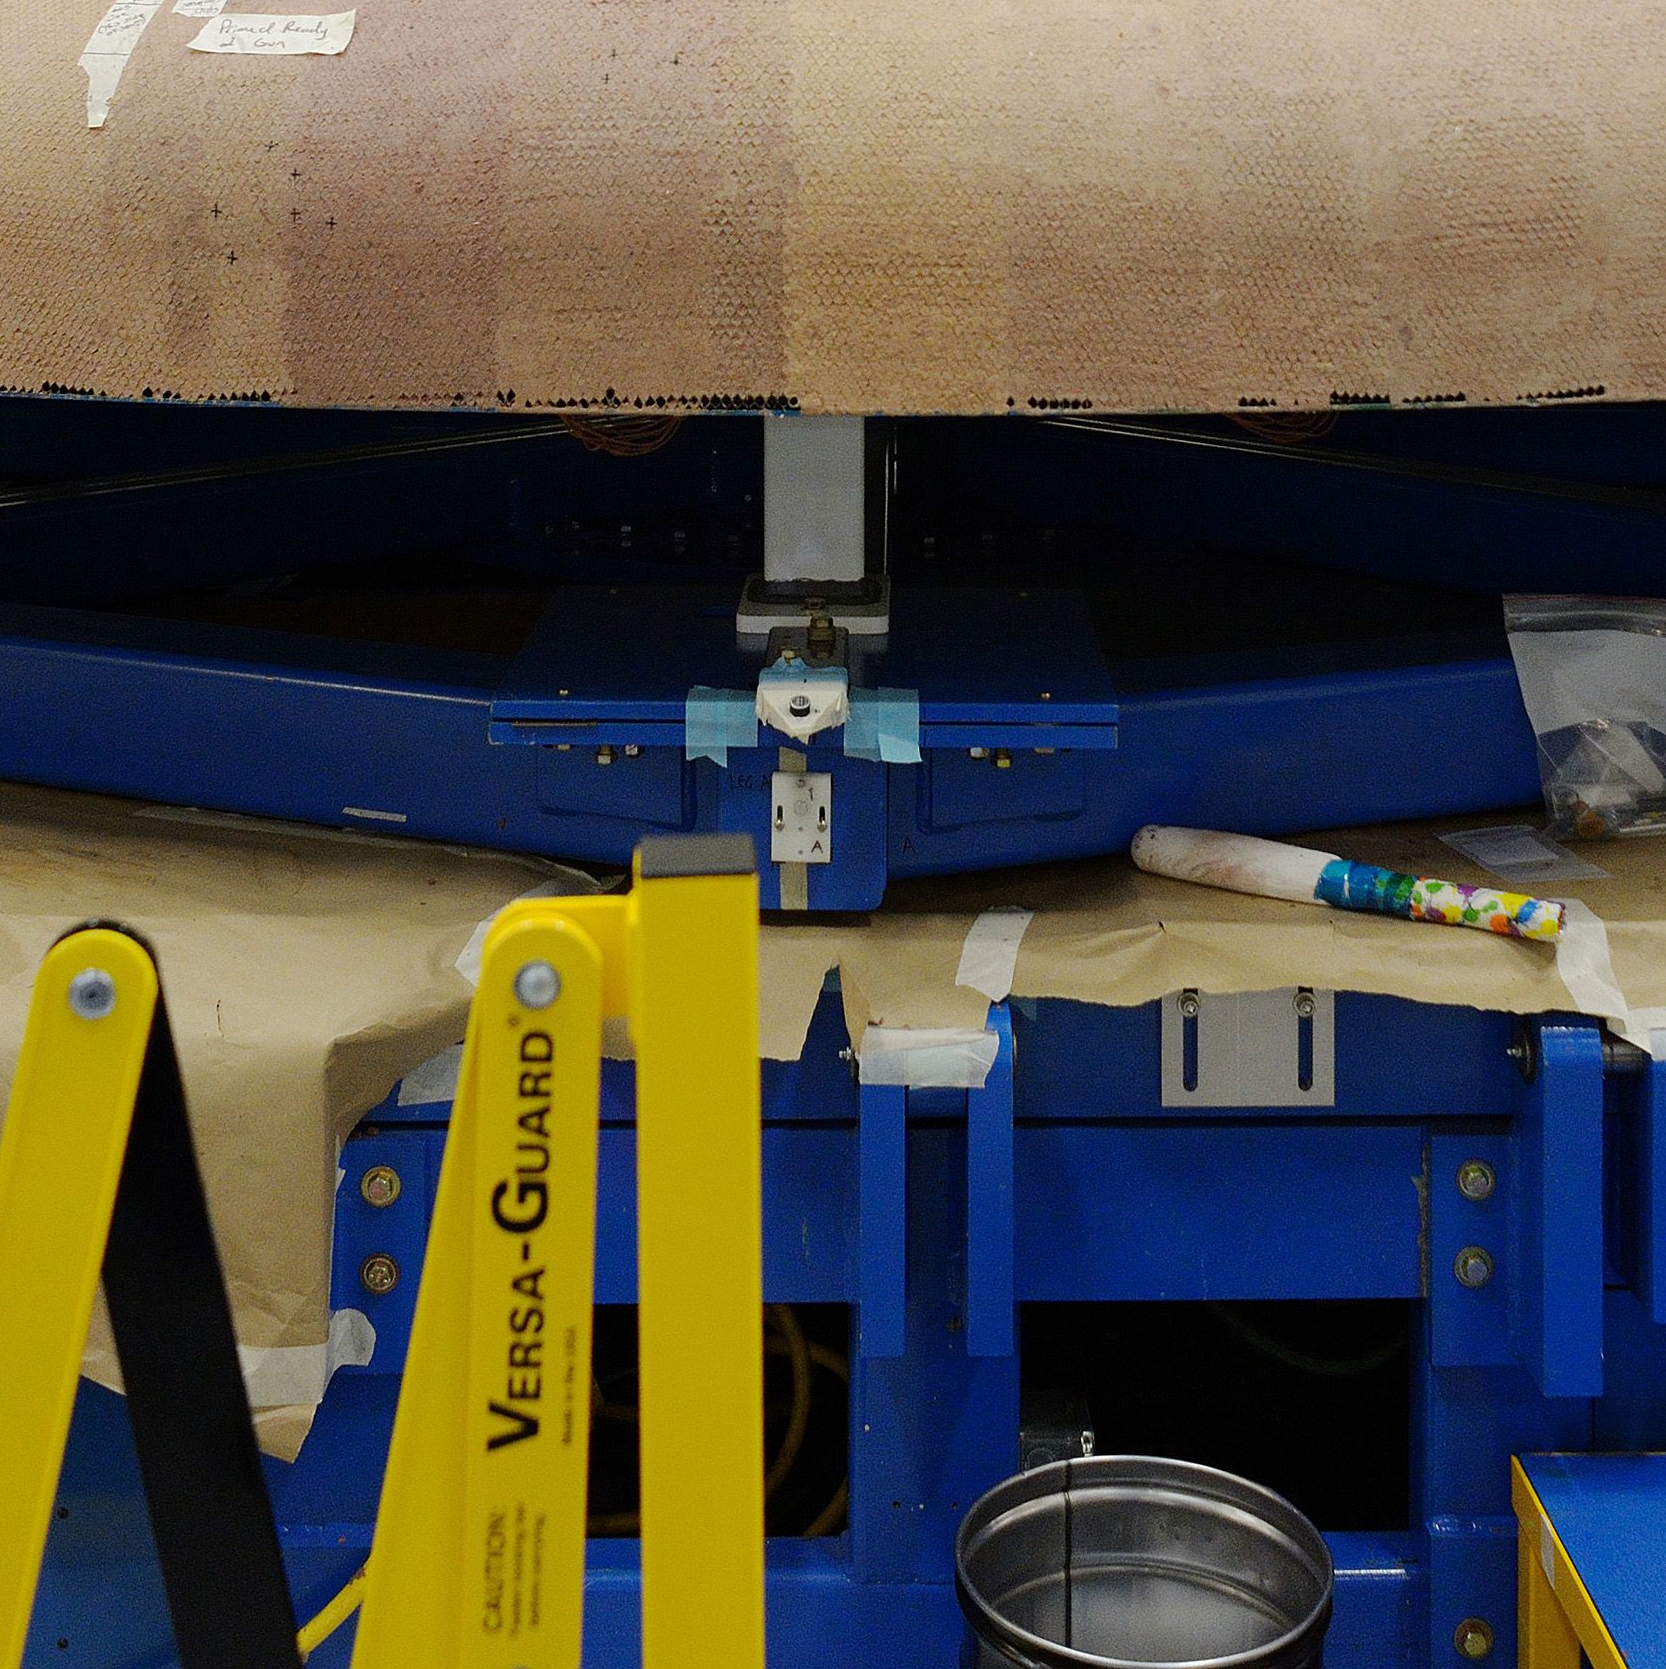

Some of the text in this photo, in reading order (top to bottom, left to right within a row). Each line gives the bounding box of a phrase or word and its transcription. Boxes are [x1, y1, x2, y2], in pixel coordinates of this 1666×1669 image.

[219, 18, 329, 40] Primed Ready
[254, 40, 285, 49] Gun
[810, 839, 824, 854] A
[901, 836, 917, 855] A
[487, 1030, 554, 1451] VERSA-GUARD
